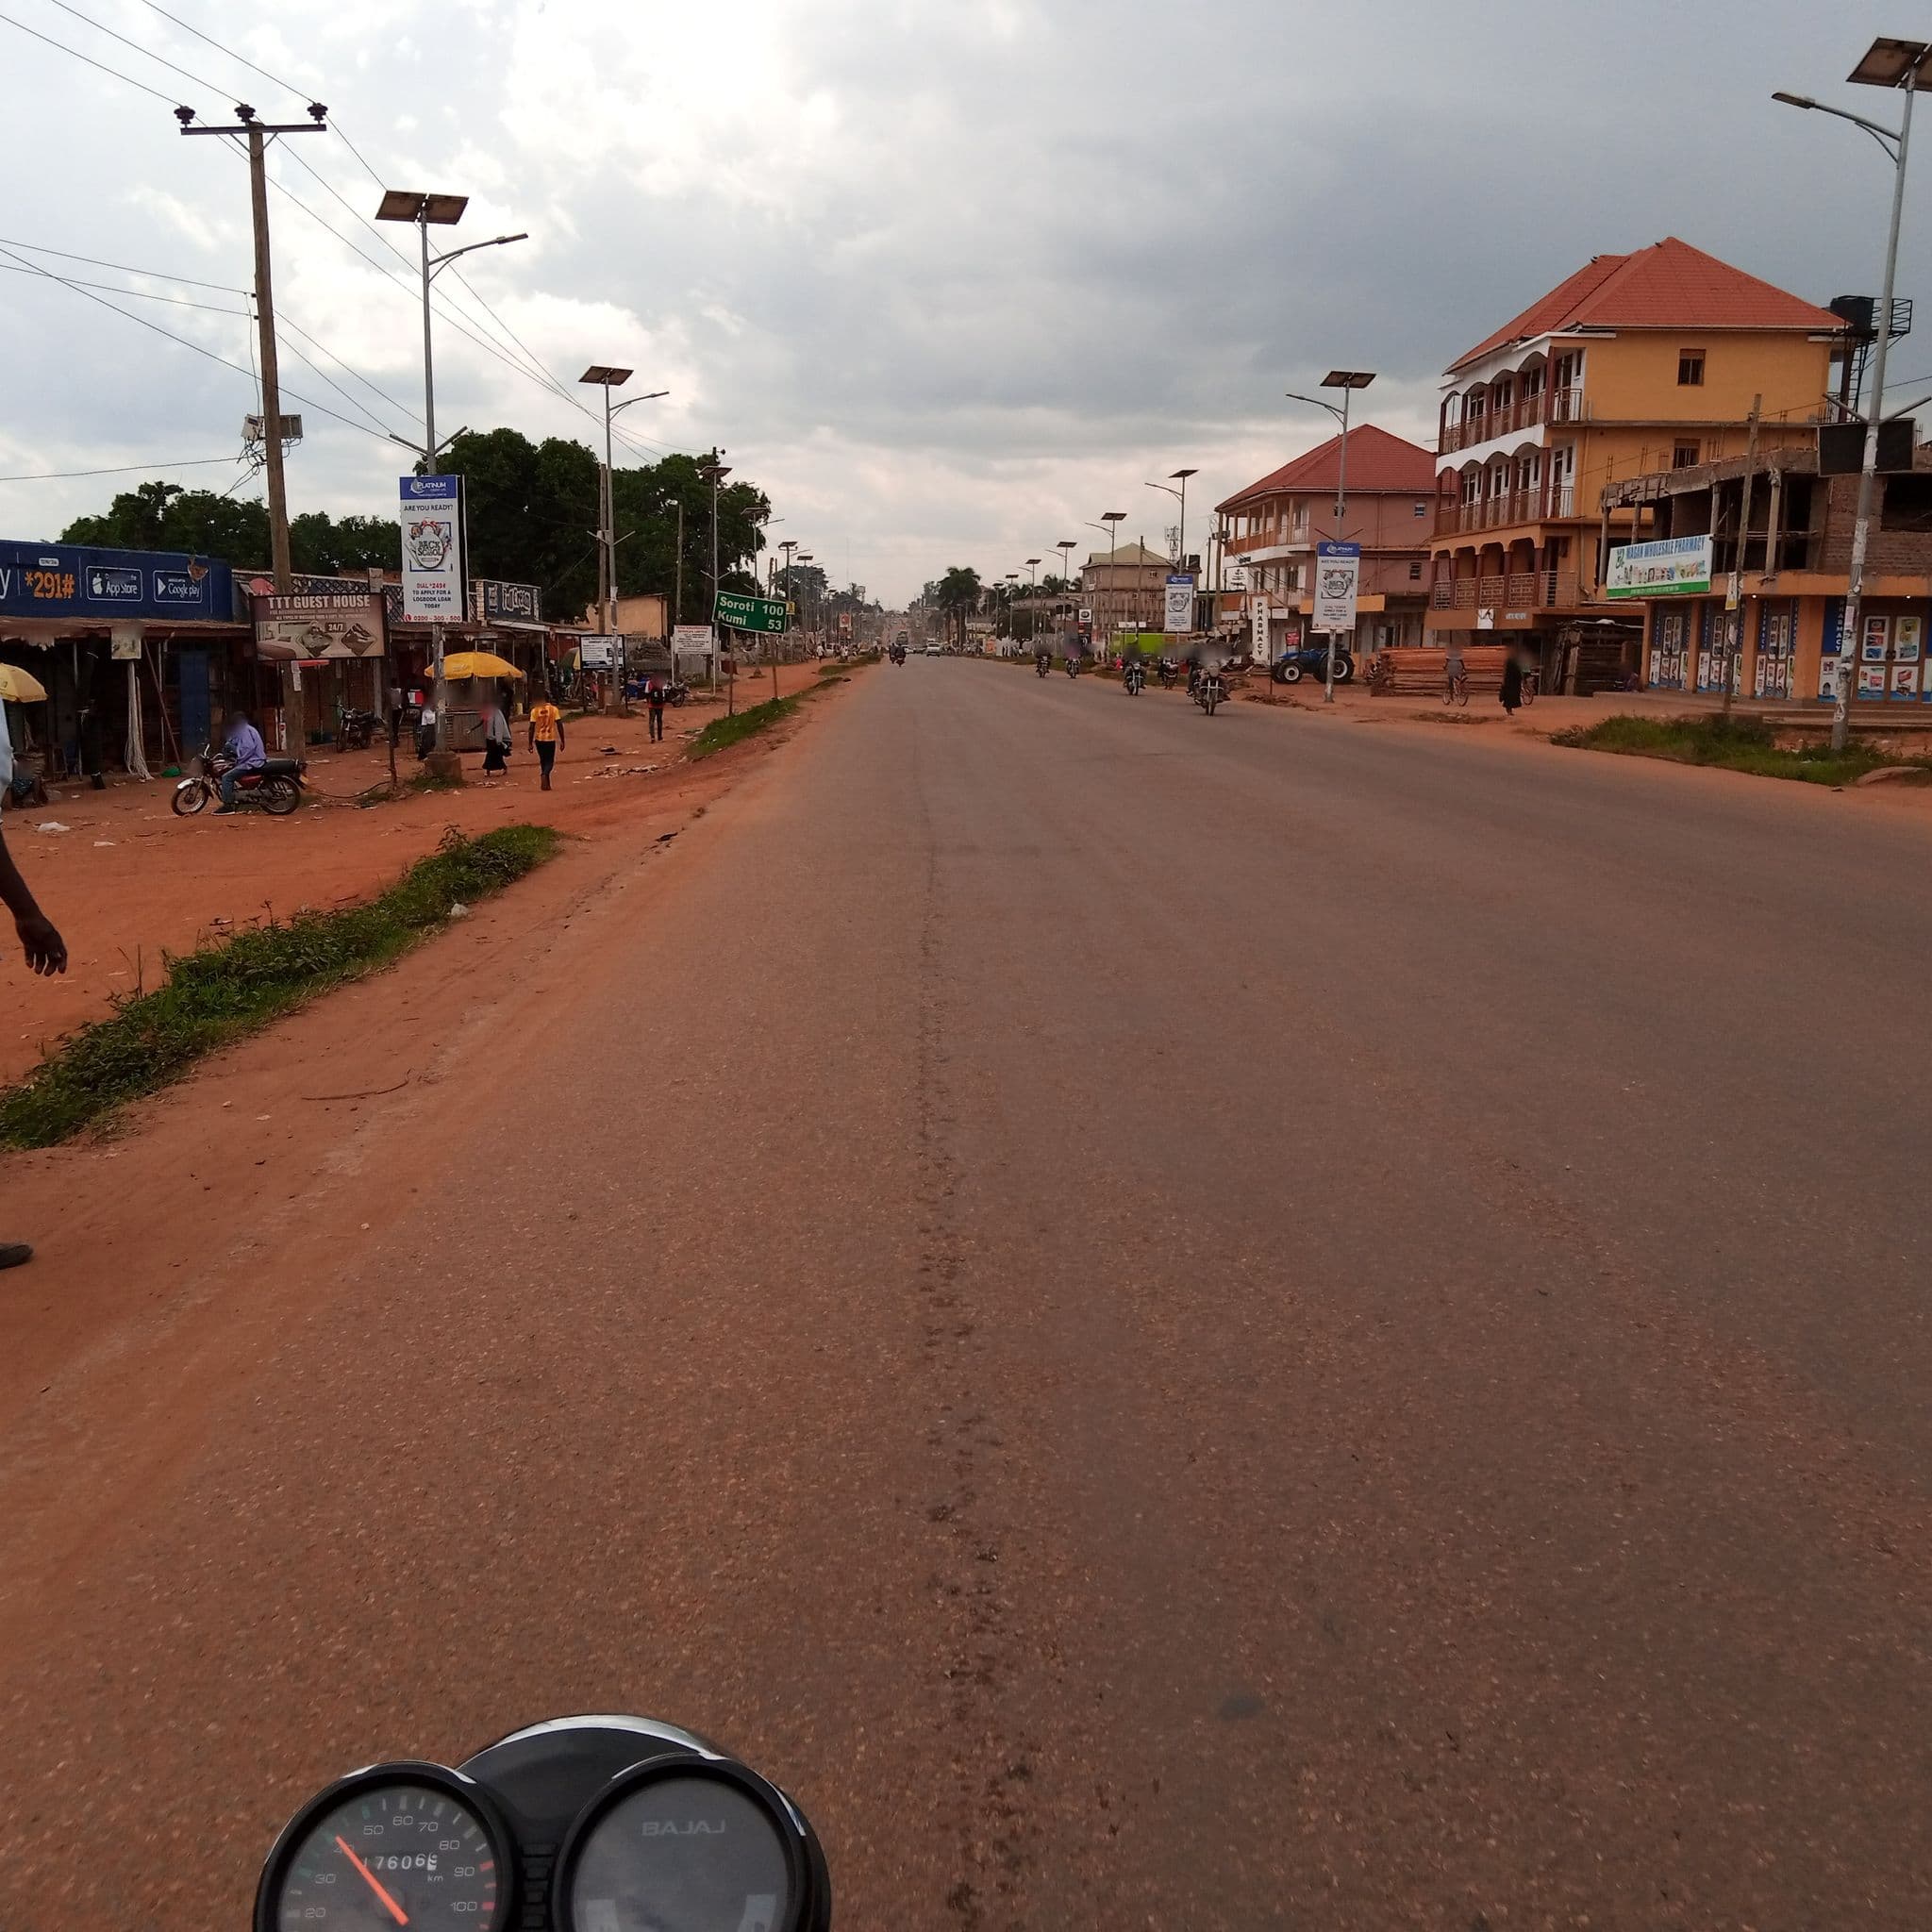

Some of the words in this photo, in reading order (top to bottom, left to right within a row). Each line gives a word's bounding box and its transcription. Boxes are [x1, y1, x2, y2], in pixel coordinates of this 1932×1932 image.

[106, 580, 120, 597] App
[121, 584, 138, 594] Store
[168, 582, 188, 598] Google
[268, 596, 291, 609] TTT
[293, 595, 329, 608] GUEST
[332, 594, 371, 608] HOUSE
[720, 596, 755, 612] Soroti
[762, 605, 784, 616] 100
[717, 610, 747, 625] Kumi
[768, 619, 782, 630] 53
[328, 623, 343, 632] 24/7
[392, 1816, 413, 1825] 60
[363, 1825, 384, 1835] 50
[418, 1823, 438, 1832] 70
[641, 1820, 725, 1836] BAJAJ
[440, 1840, 459, 1850] 80
[454, 1867, 475, 1876] 90
[315, 1874, 336, 1884] 30
[427, 1874, 443, 1882] km
[451, 1902, 477, 1911] 100
[305, 1908, 325, 1918] 20
